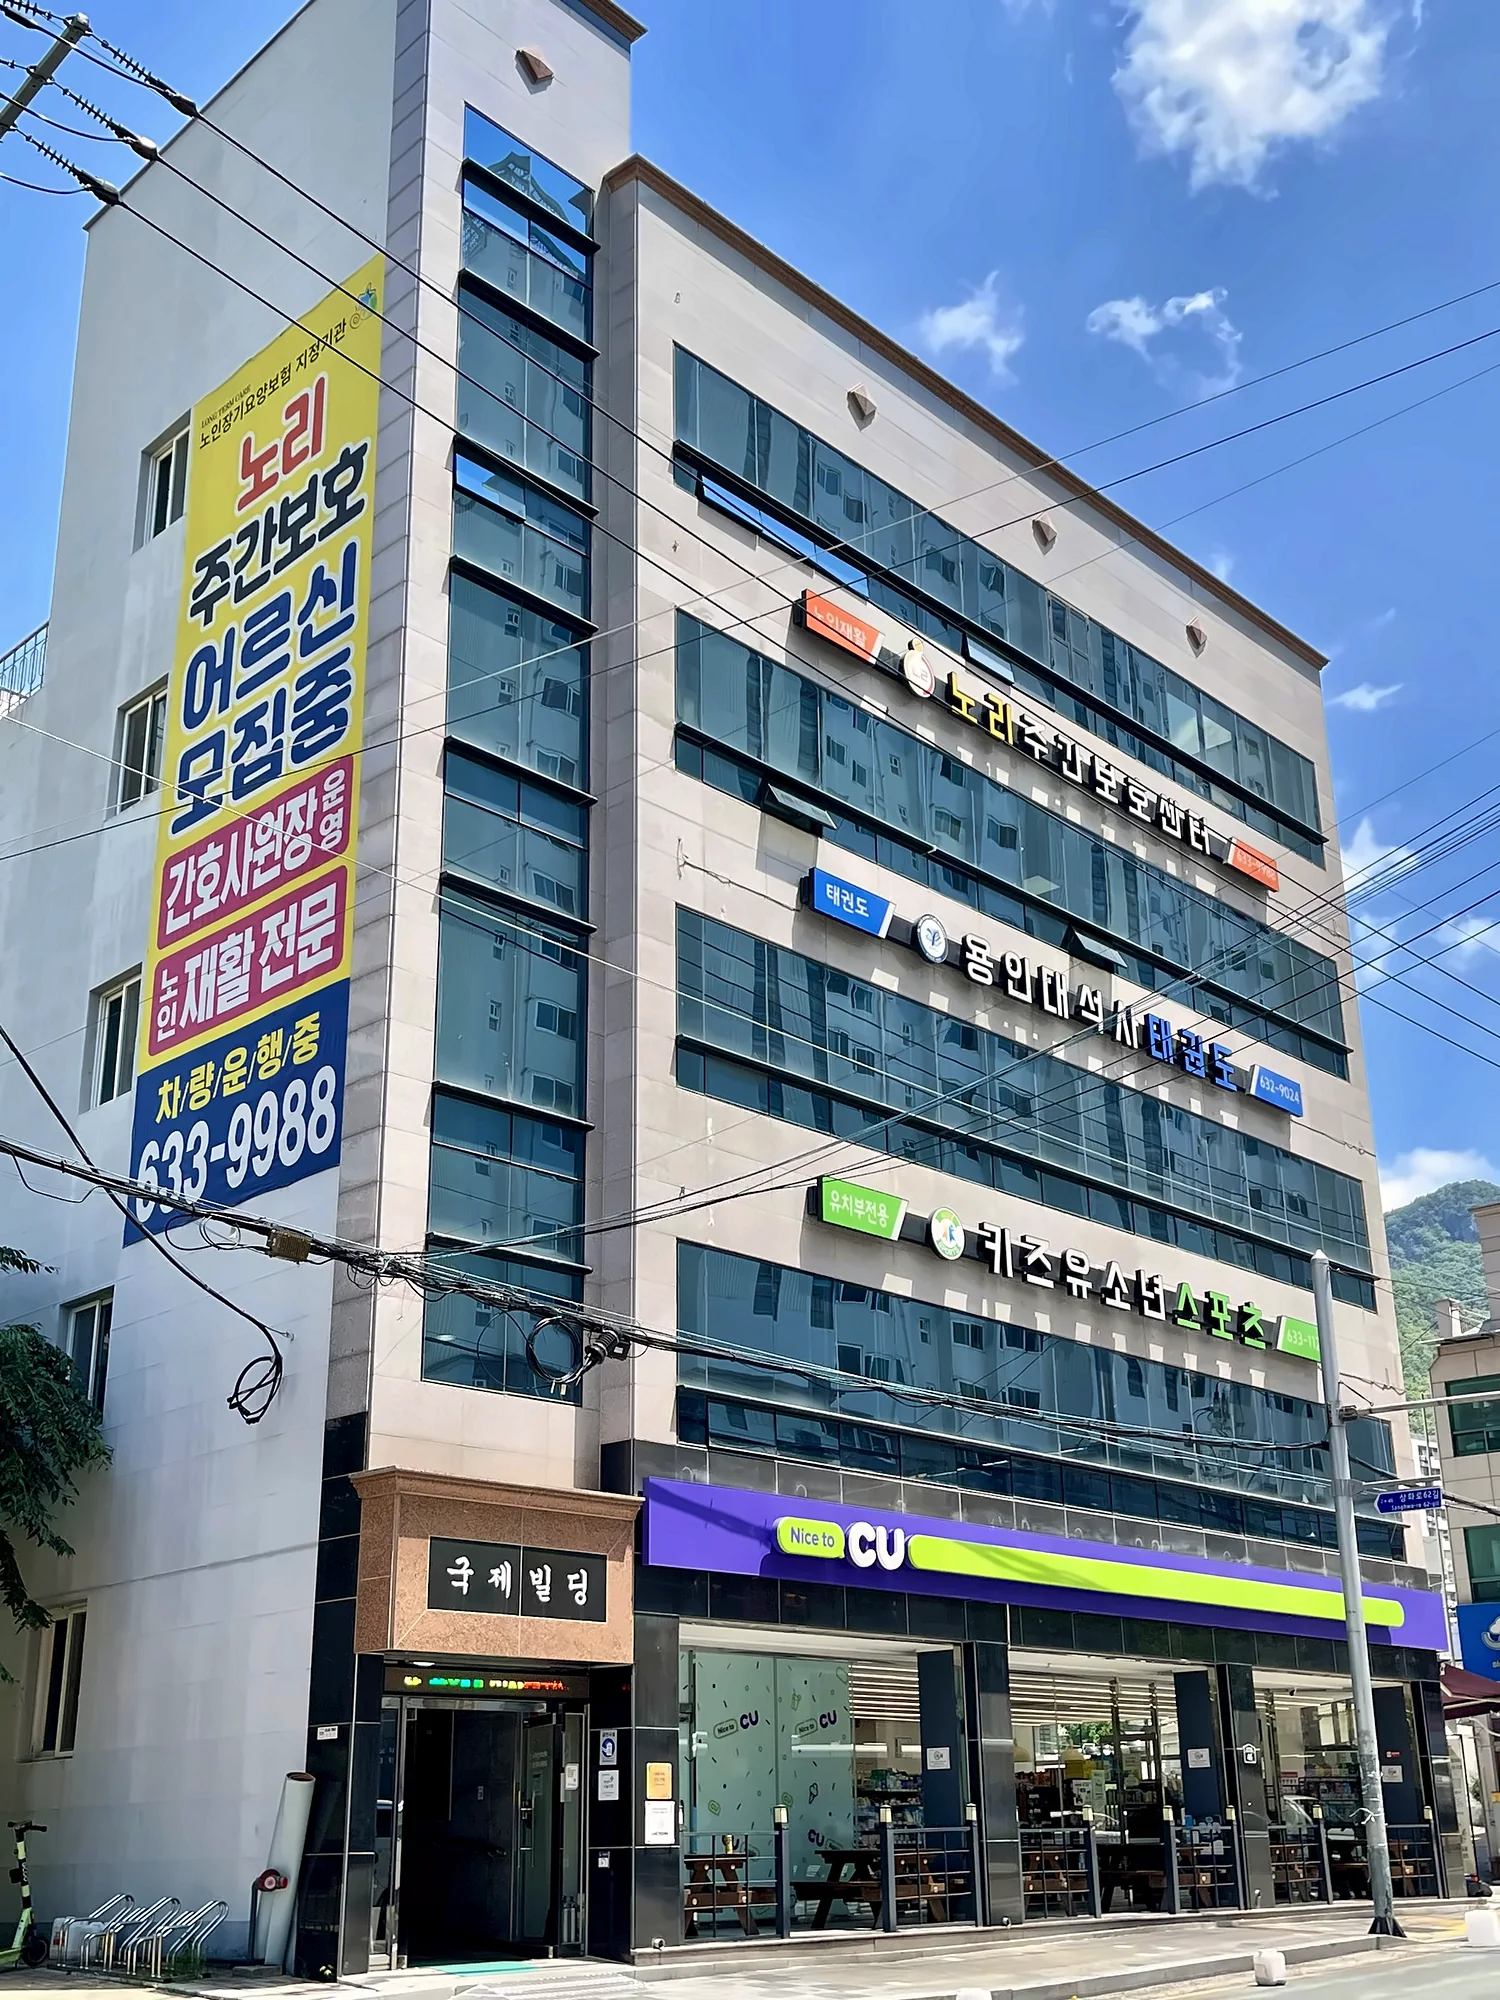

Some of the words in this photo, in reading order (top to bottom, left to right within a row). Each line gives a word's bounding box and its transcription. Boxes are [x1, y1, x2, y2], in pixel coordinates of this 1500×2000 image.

[200, 362, 292, 449] 노인장기요양보험
[295, 318, 347, 372] 지정기관
[237, 376, 325, 511] 노리
[190, 442, 368, 627] 주간보호
[183, 542, 357, 729] 어르신
[171, 647, 352, 835] 모집중
[826, 883, 869, 918] 태권도
[157, 968, 179, 1043] 노인
[258, 881, 337, 994] 전문
[1260, 1074, 1300, 1103] 632-9024
[135, 1065, 336, 1223] 633-9988
[829, 1190, 890, 1229] 유치부전용
[790, 1527, 819, 1546] Nice
[821, 1531, 835, 1548] to
[848, 1521, 906, 1571] CU
[717, 1725, 729, 1735] Nice
[728, 1723, 735, 1731] to
[740, 1710, 759, 1729] CU
[819, 1710, 838, 1729] CU
[808, 1829, 825, 1847] CU
